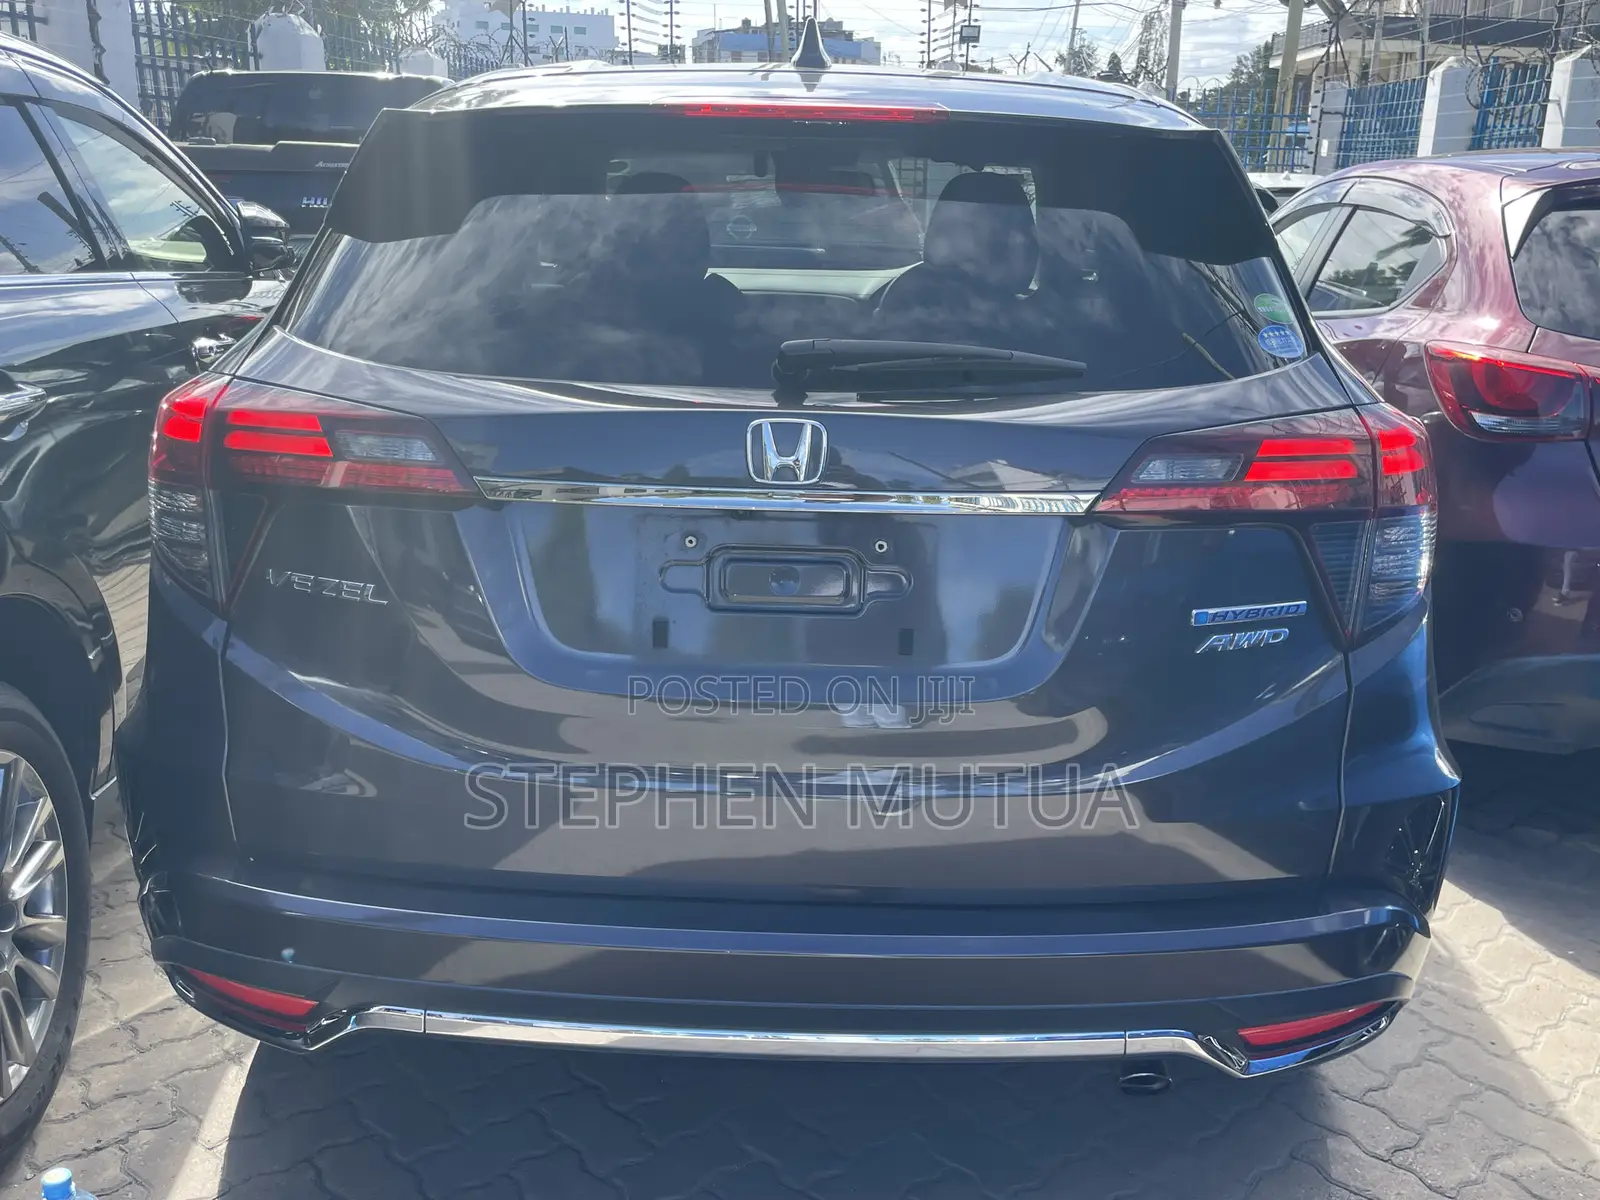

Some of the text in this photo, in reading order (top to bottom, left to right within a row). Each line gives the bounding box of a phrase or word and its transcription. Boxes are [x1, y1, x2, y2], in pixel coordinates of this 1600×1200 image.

[265, 569, 388, 605] VEZEL
[1209, 603, 1301, 623] HYBRID
[1195, 628, 1290, 654] AWD
